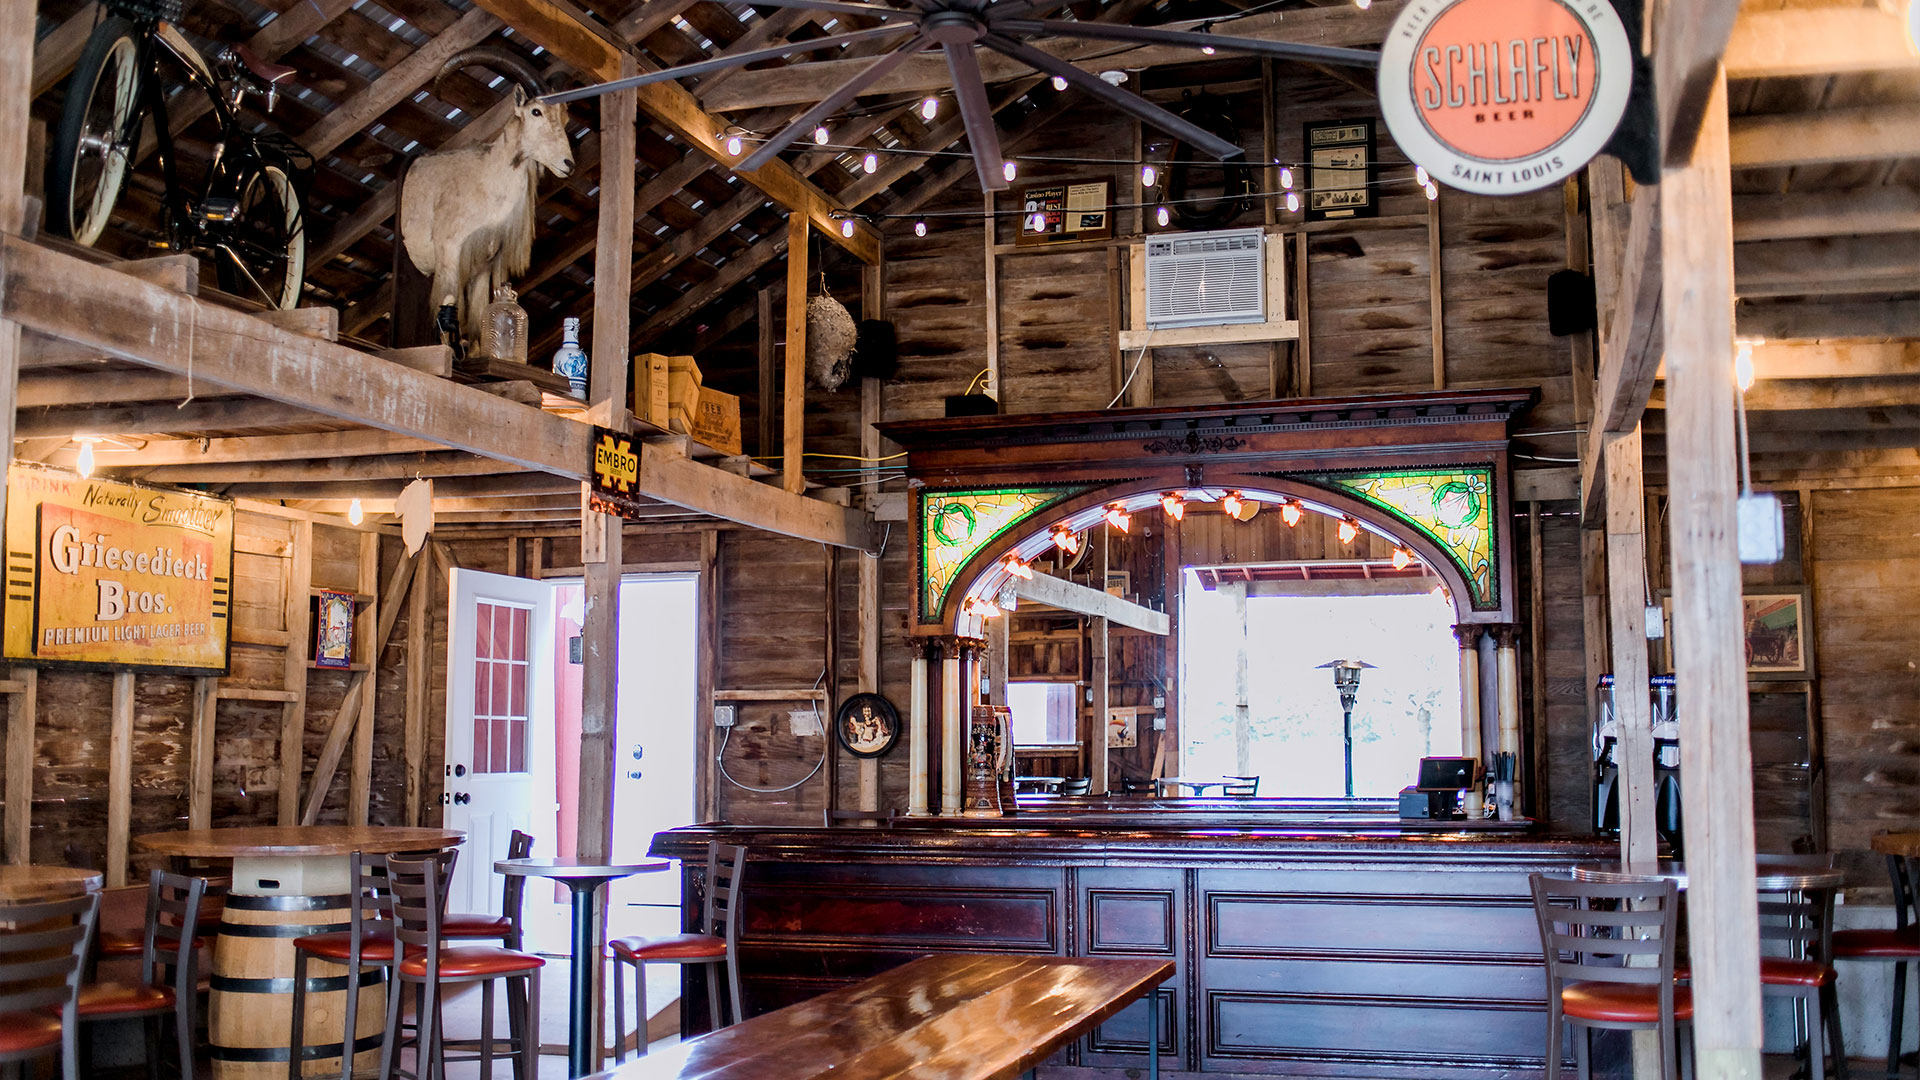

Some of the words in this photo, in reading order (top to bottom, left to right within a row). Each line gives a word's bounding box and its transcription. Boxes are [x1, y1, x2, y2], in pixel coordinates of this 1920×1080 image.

[1423, 35, 1582, 109] SCHLAFLY
[1475, 109, 1534, 123] BEER
[1452, 164, 1504, 184] SAINT
[1512, 156, 1564, 183] LOUIS
[1025, 191, 1045, 199] Casino
[1045, 190, 1062, 199] Player
[597, 447, 636, 473] EMBRO
[83, 484, 141, 517] Naturally
[142, 495, 223, 531] Smoother
[50, 523, 208, 581] Griesedieck
[95, 578, 173, 621] Bros.
[44, 626, 109, 646] PREMIUM
[114, 625, 146, 641] LIGHT
[150, 623, 181, 638] LAGER
[184, 623, 206, 636] BEER
